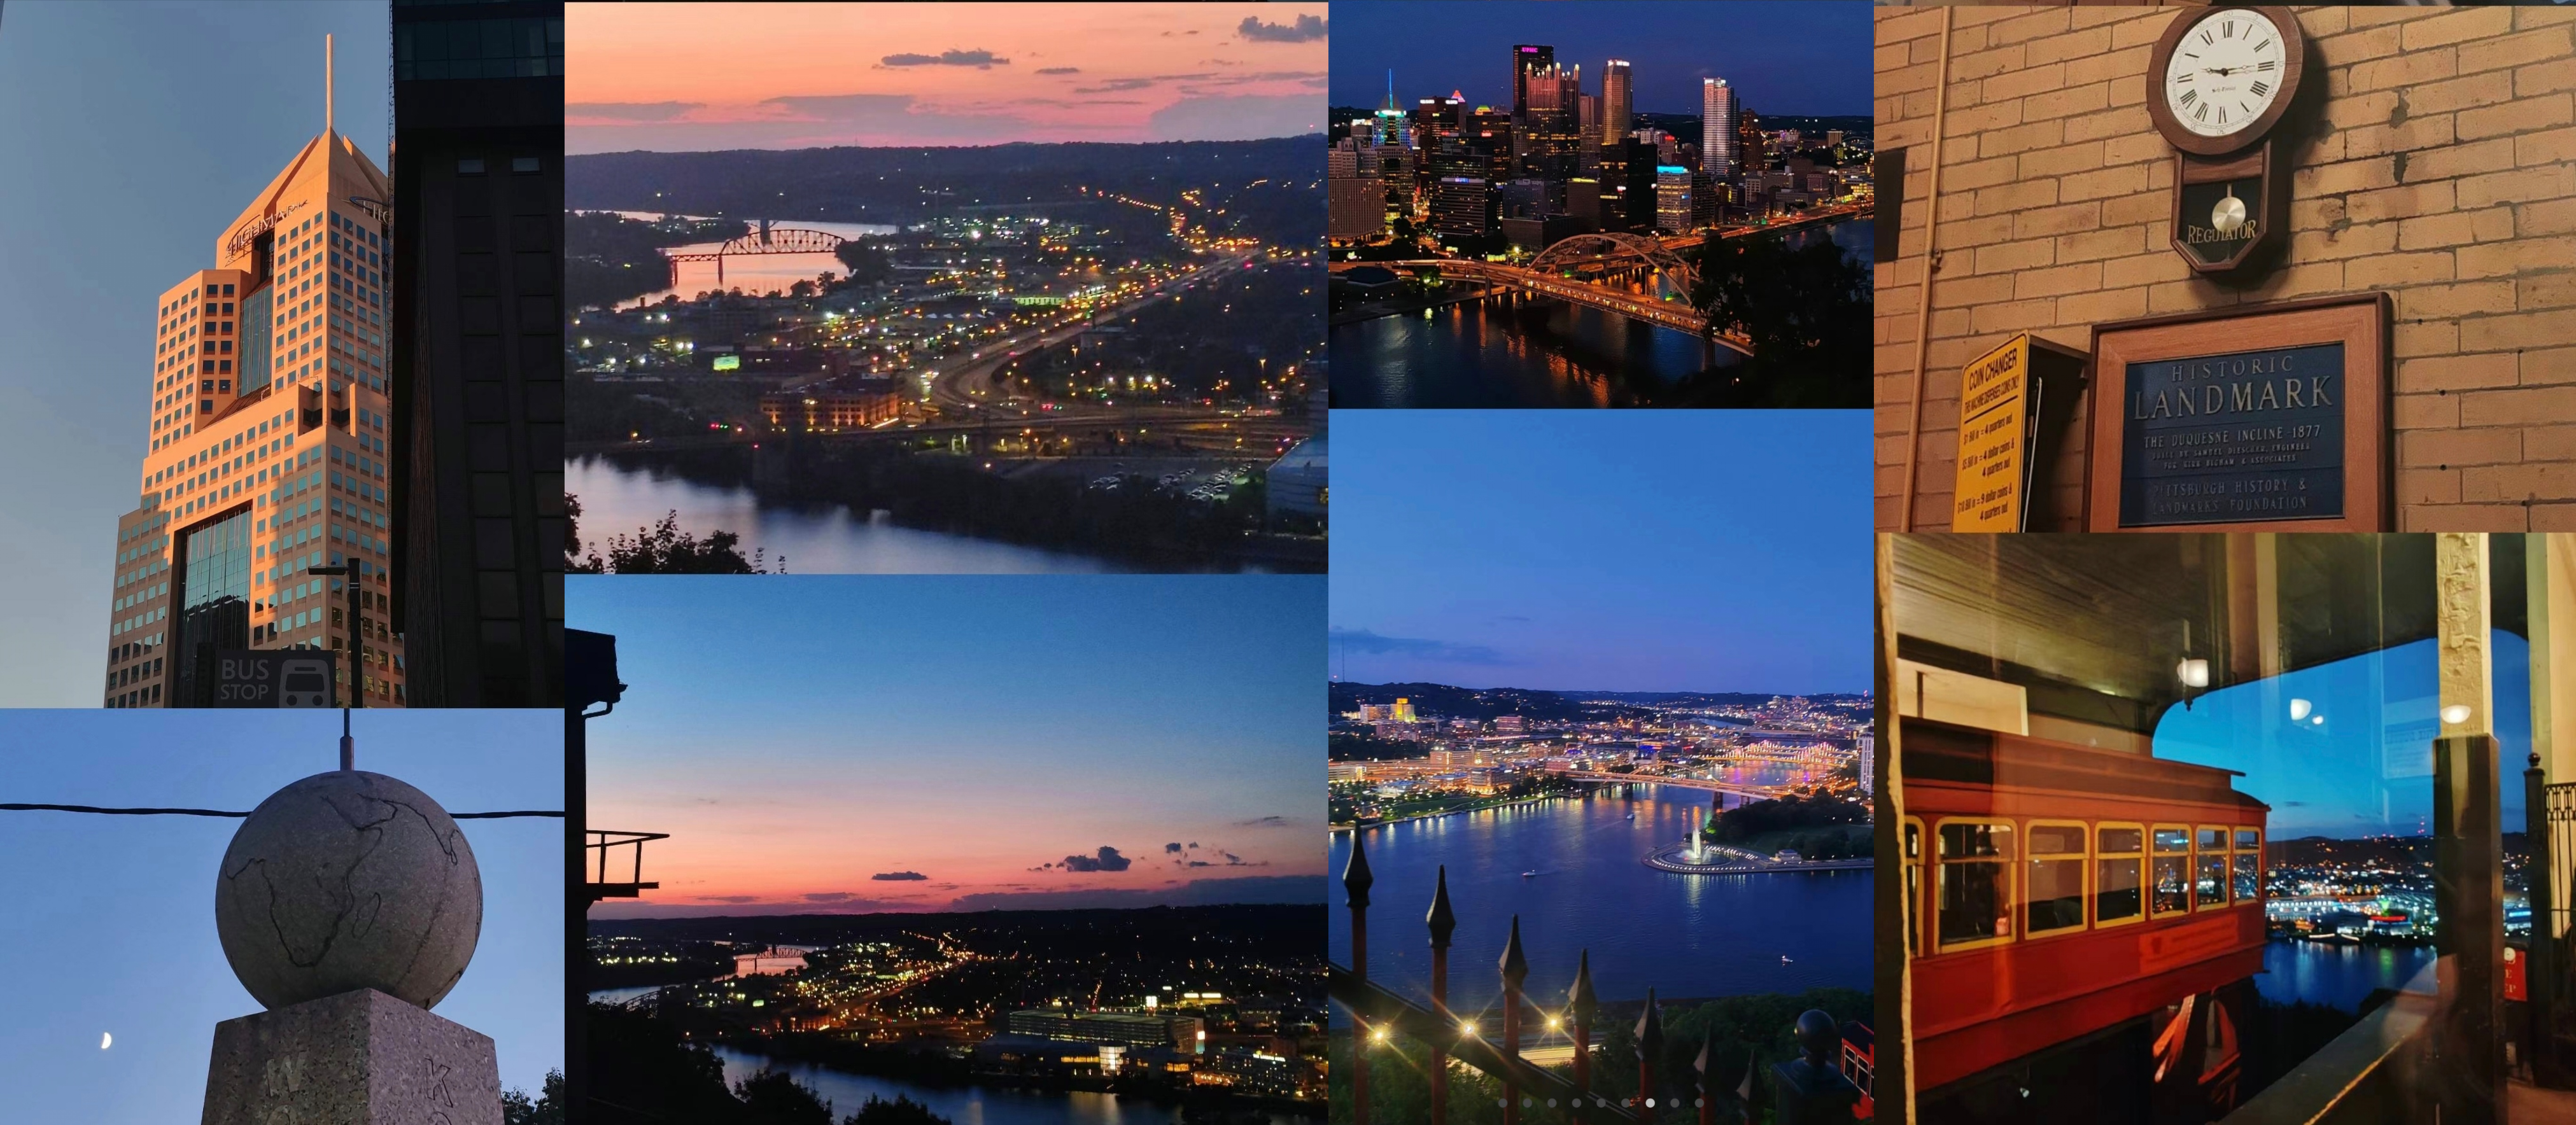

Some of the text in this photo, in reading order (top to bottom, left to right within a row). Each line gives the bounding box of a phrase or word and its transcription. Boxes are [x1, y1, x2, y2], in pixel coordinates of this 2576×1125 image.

[2258, 60, 2275, 71] III
[229, 199, 309, 256] HIGHMARK
[2187, 220, 2257, 244] REGULATOR
[1969, 347, 2017, 391] COIN CHANGER
[2172, 355, 2294, 382] HISTORIC
[2134, 375, 2333, 421] LANDMARK
[1985, 424, 1988, 435] 4
[1989, 418, 2005, 435] quarters
[2144, 435, 2164, 449] THE
[2171, 430, 2229, 447] DUQUESNE
[2237, 426, 2283, 442] INCLINE
[1983, 450, 1987, 461] 4
[2193, 447, 2223, 458] SAMUEL
[2271, 442, 2311, 452] ENGINEER
[2251, 454, 2297, 465] ASSOCIATES
[1982, 467, 1986, 477] 4
[2153, 477, 2307, 498] PITTSBURGH HISTORY &
[1981, 493, 1985, 504] 9
[2151, 496, 2307, 515] LANDMARKS FOUNDATION
[1980, 510, 1983, 521] 4
[221, 659, 269, 680] BUS
[220, 684, 269, 701] STOP
